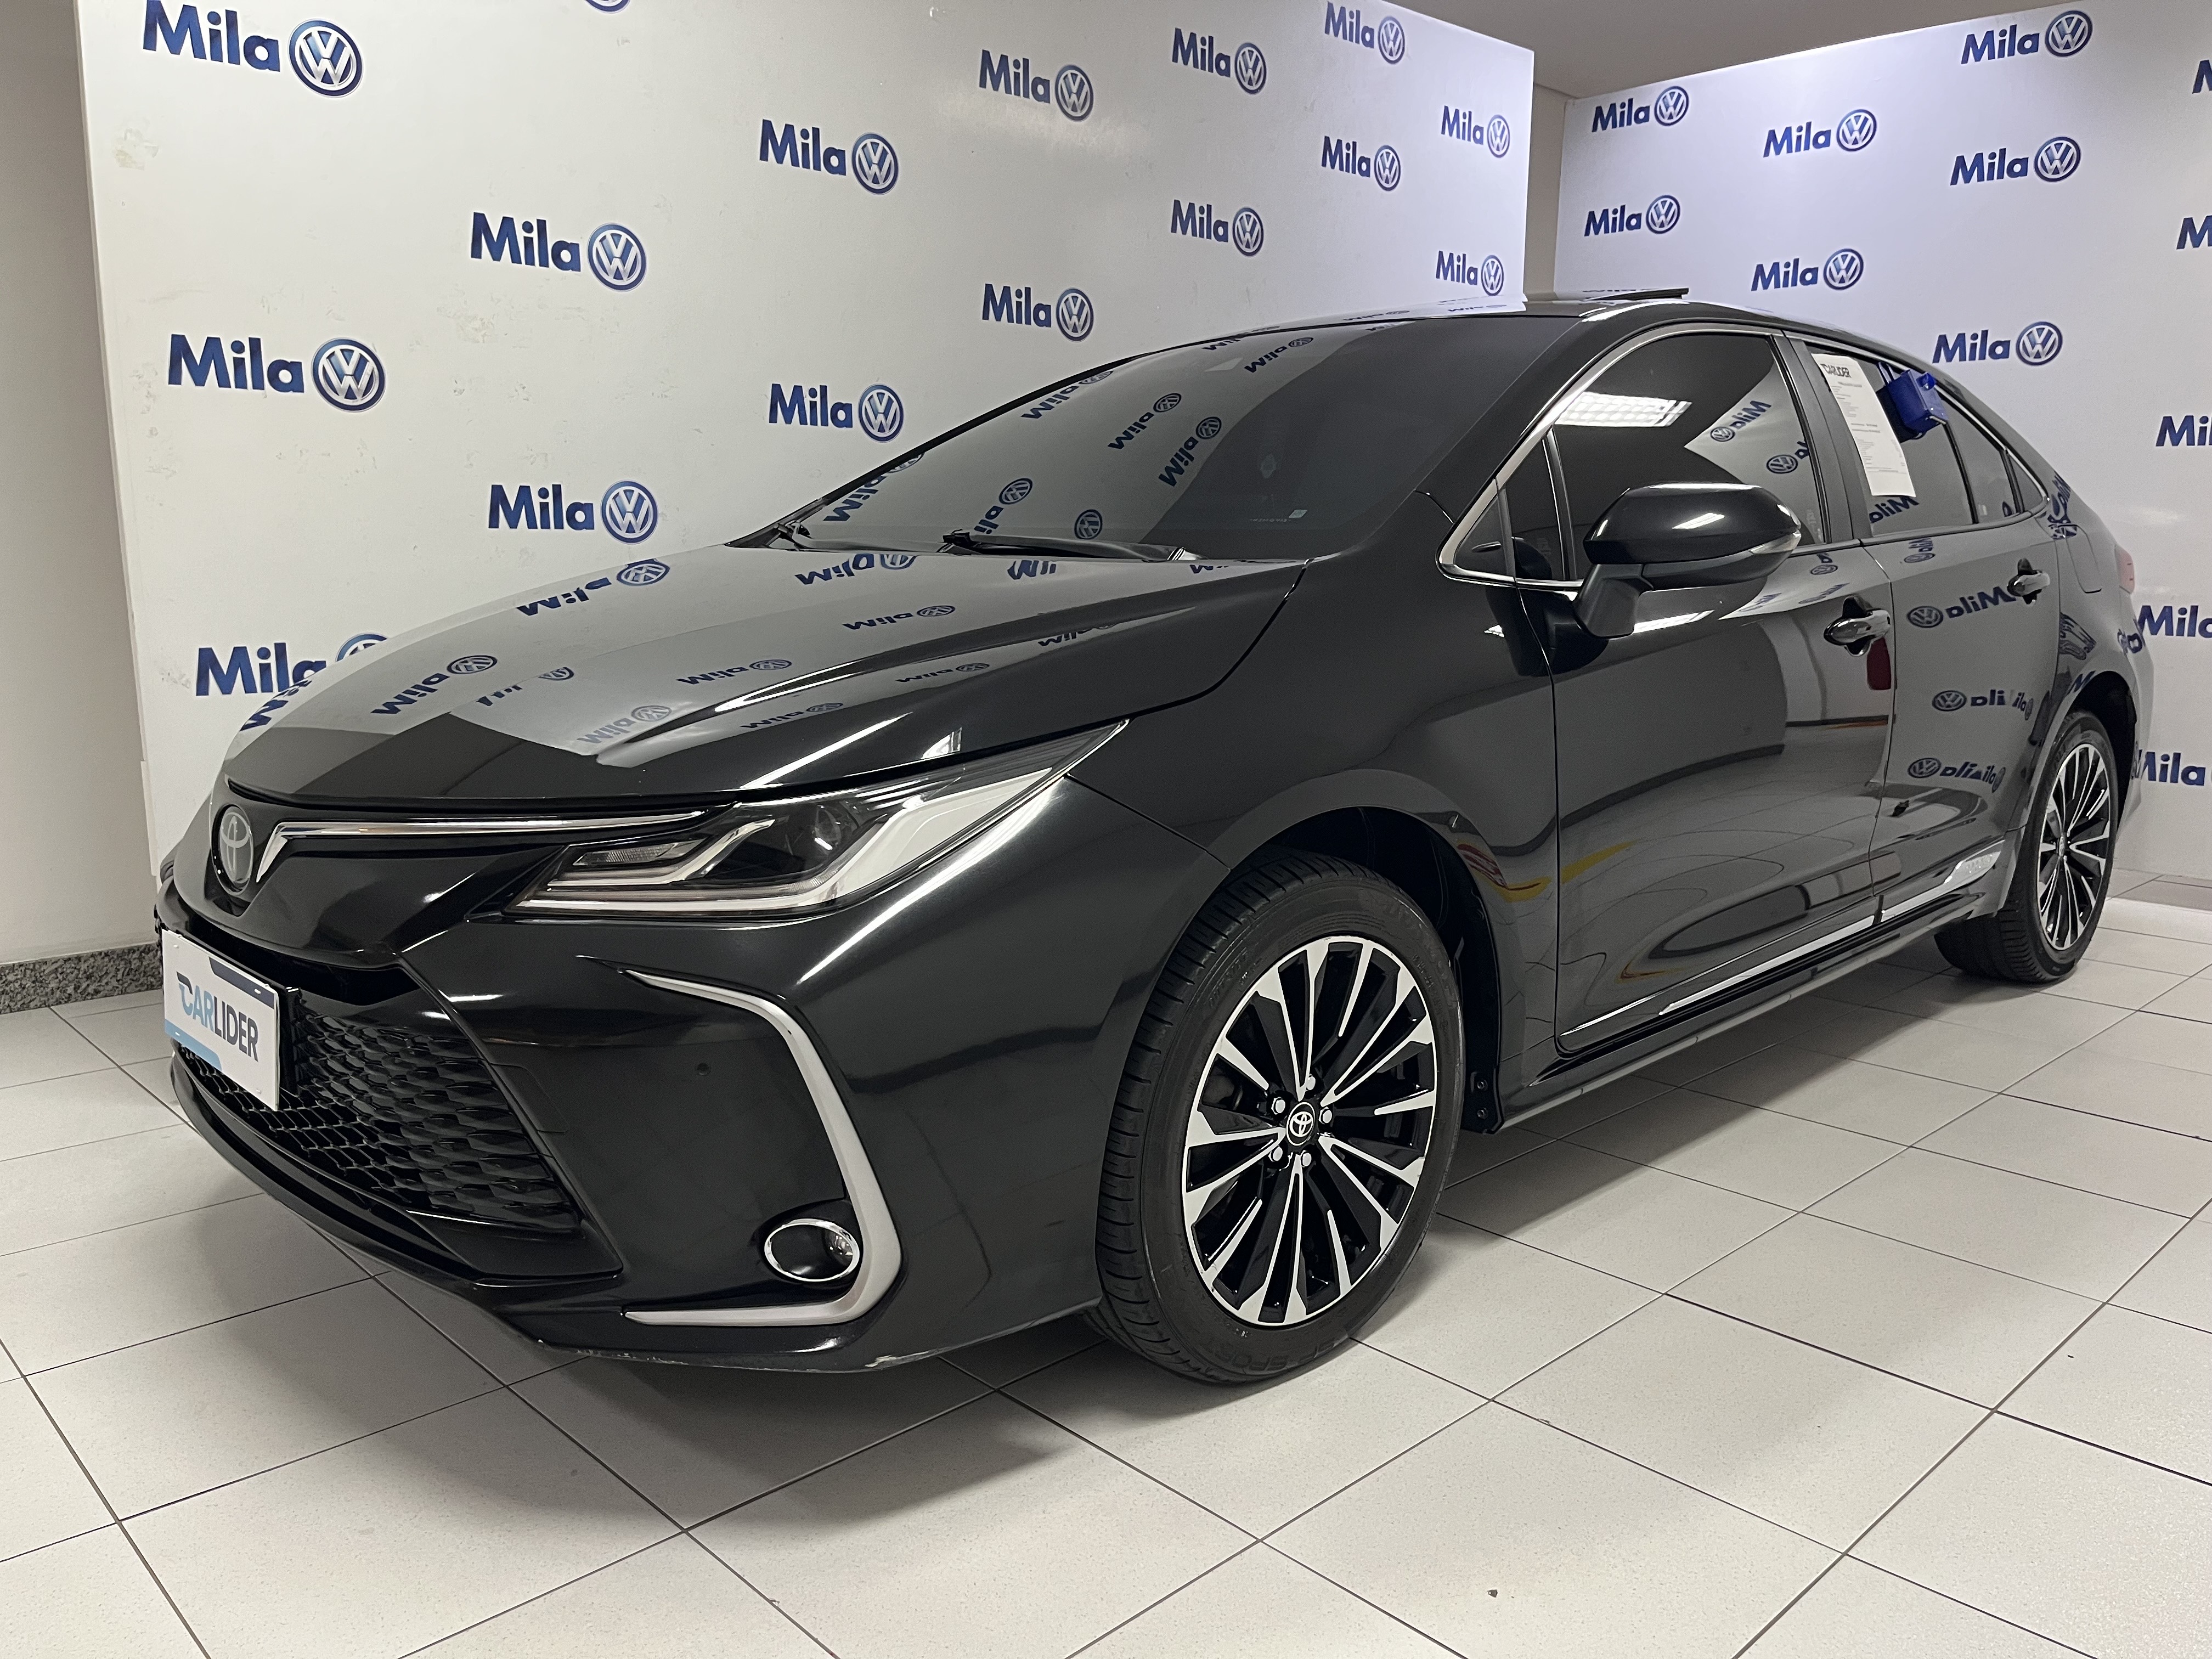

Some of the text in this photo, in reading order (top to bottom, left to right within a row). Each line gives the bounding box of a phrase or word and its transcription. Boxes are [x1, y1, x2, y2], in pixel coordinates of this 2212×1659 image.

[143, 0, 280, 72] Mila
[1325, 1, 1374, 48] Mila
[1961, 24, 2040, 64] Mila
[1172, 27, 1231, 77] Mila
[979, 49, 1050, 104] Mila
[1441, 105, 1484, 145] Mila
[1591, 99, 1650, 133] Mila
[759, 119, 846, 176] Mila
[1322, 136, 1370, 178] Mila
[1763, 121, 1831, 157] Mila
[1950, 148, 2029, 185] Mila
[471, 212, 581, 272] Mila
[1171, 200, 1228, 242] Mila
[1584, 205, 1642, 236] Mila
[1436, 251, 1478, 285] Mila
[1751, 258, 1819, 291] Mila
[982, 284, 1051, 328] Mila
[168, 334, 304, 393] Mila
[1932, 329, 2011, 363] Mila
[769, 383, 853, 428] Mila
[488, 484, 595, 531] Mila
[177, 972, 258, 1062] CARLIDER
